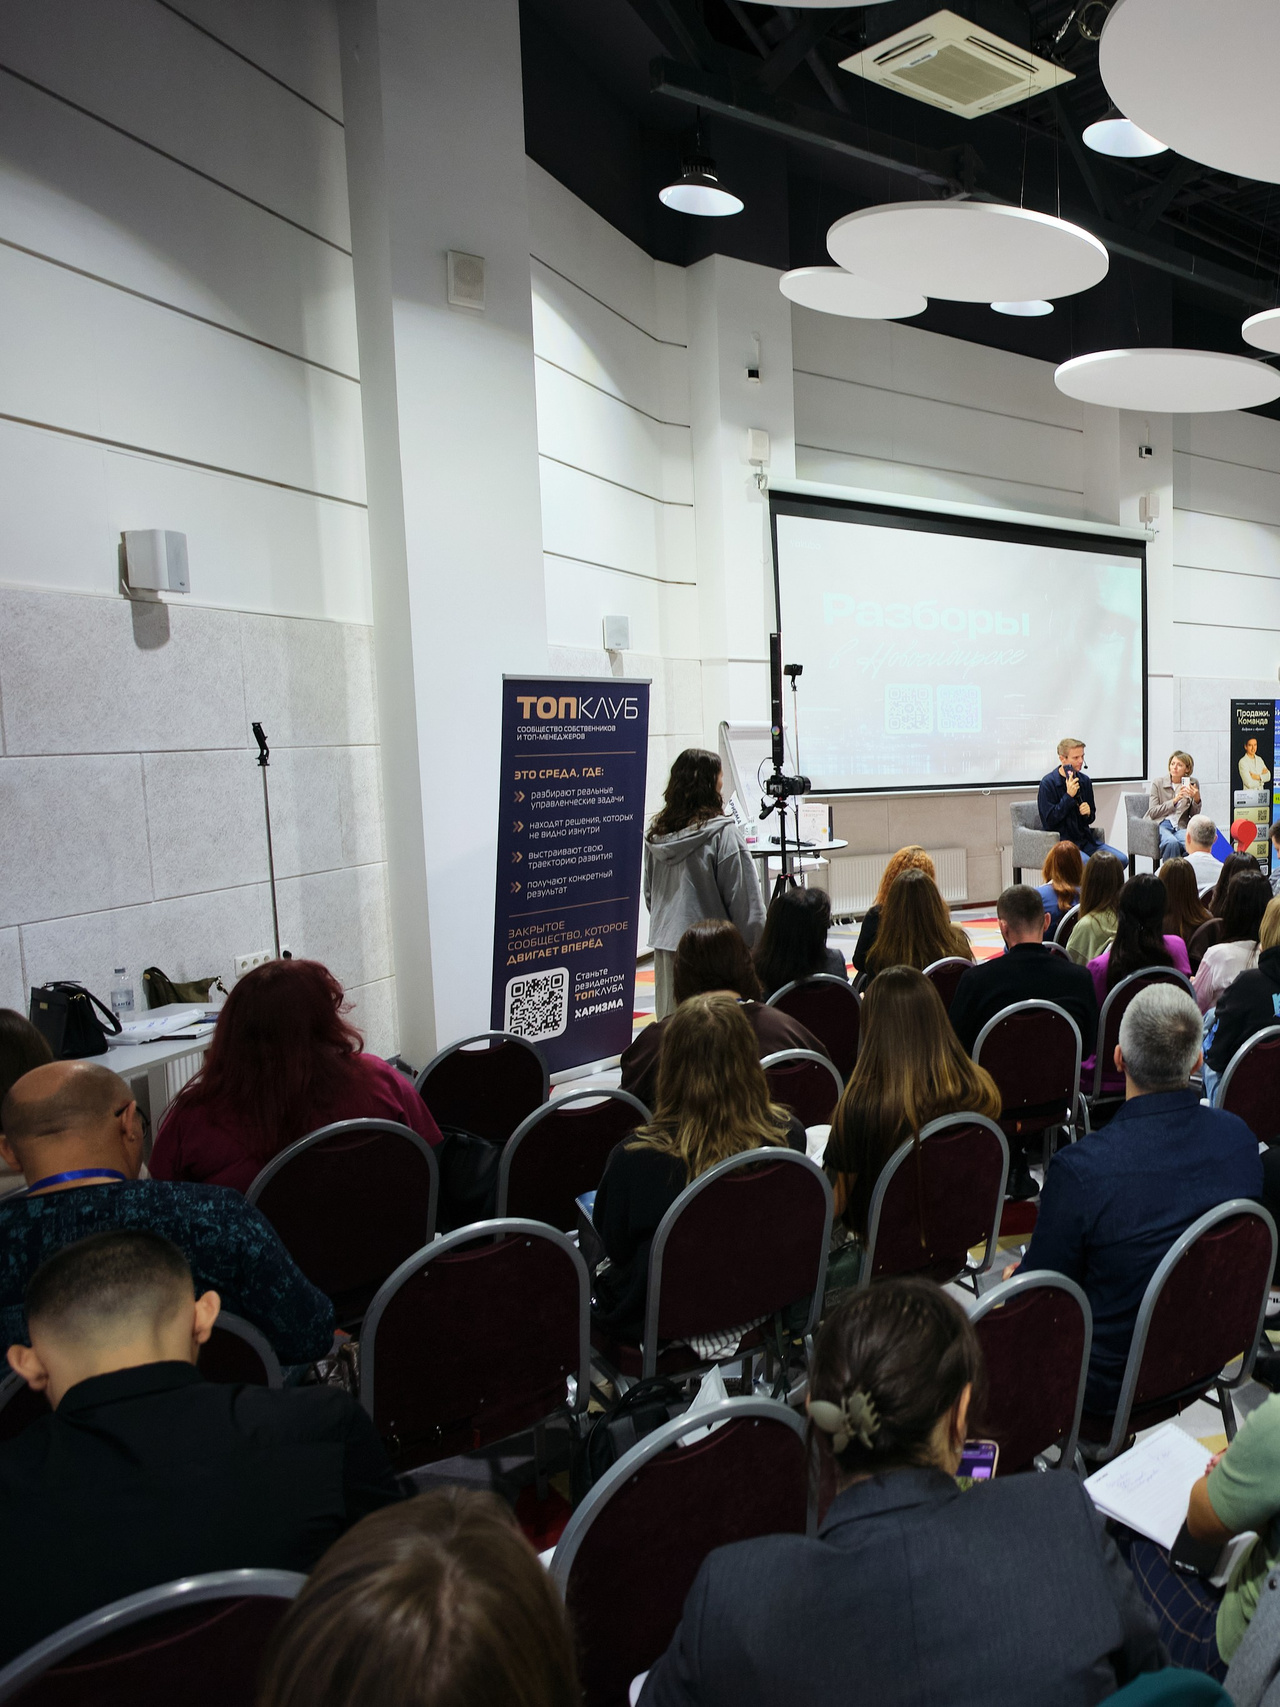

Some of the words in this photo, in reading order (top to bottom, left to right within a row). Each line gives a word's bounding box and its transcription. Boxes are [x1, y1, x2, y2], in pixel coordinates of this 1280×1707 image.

[822, 591, 1030, 640] Разборы
[1236, 709, 1270, 720] Продажи.
[1238, 718, 1268, 726] Команда
[523, 733, 586, 741] ТОП-МЕНЕДЖЕРОВ
[514, 770, 536, 780] ЭТО
[538, 768, 580, 780] СРЕДА,
[582, 767, 604, 778] ГДЕ:
[530, 790, 575, 800] разбирают
[577, 786, 614, 798] реальные
[530, 798, 596, 810] управленческие
[598, 796, 624, 804] задачи
[530, 820, 563, 830] находят
[565, 816, 601, 826] решения,
[602, 814, 634, 822] которых
[541, 828, 567, 838] видно
[568, 826, 600, 836] изнутри
[528, 847, 582, 860] выстраивают
[584, 844, 603, 853] свою
[528, 857, 576, 870] траекторию
[578, 852, 612, 865] развития
[527, 877, 567, 890] получают
[568, 869, 613, 883] конкретный
[527, 886, 567, 900] результат
[508, 921, 565, 939] ЗАКРЫТОЕ
[508, 931, 583, 951] СООБЩЕСТВО,
[585, 921, 628, 936] КОТОРОЕ
[506, 947, 560, 966] ДВИГАЕТ
[561, 938, 603, 954] ВПЕРЁД
[575, 968, 608, 981] Станьте
[574, 974, 625, 992] резидентом
[574, 984, 624, 1001] ТОПКЛУБА
[574, 998, 624, 1019] ХАРИЗМА
